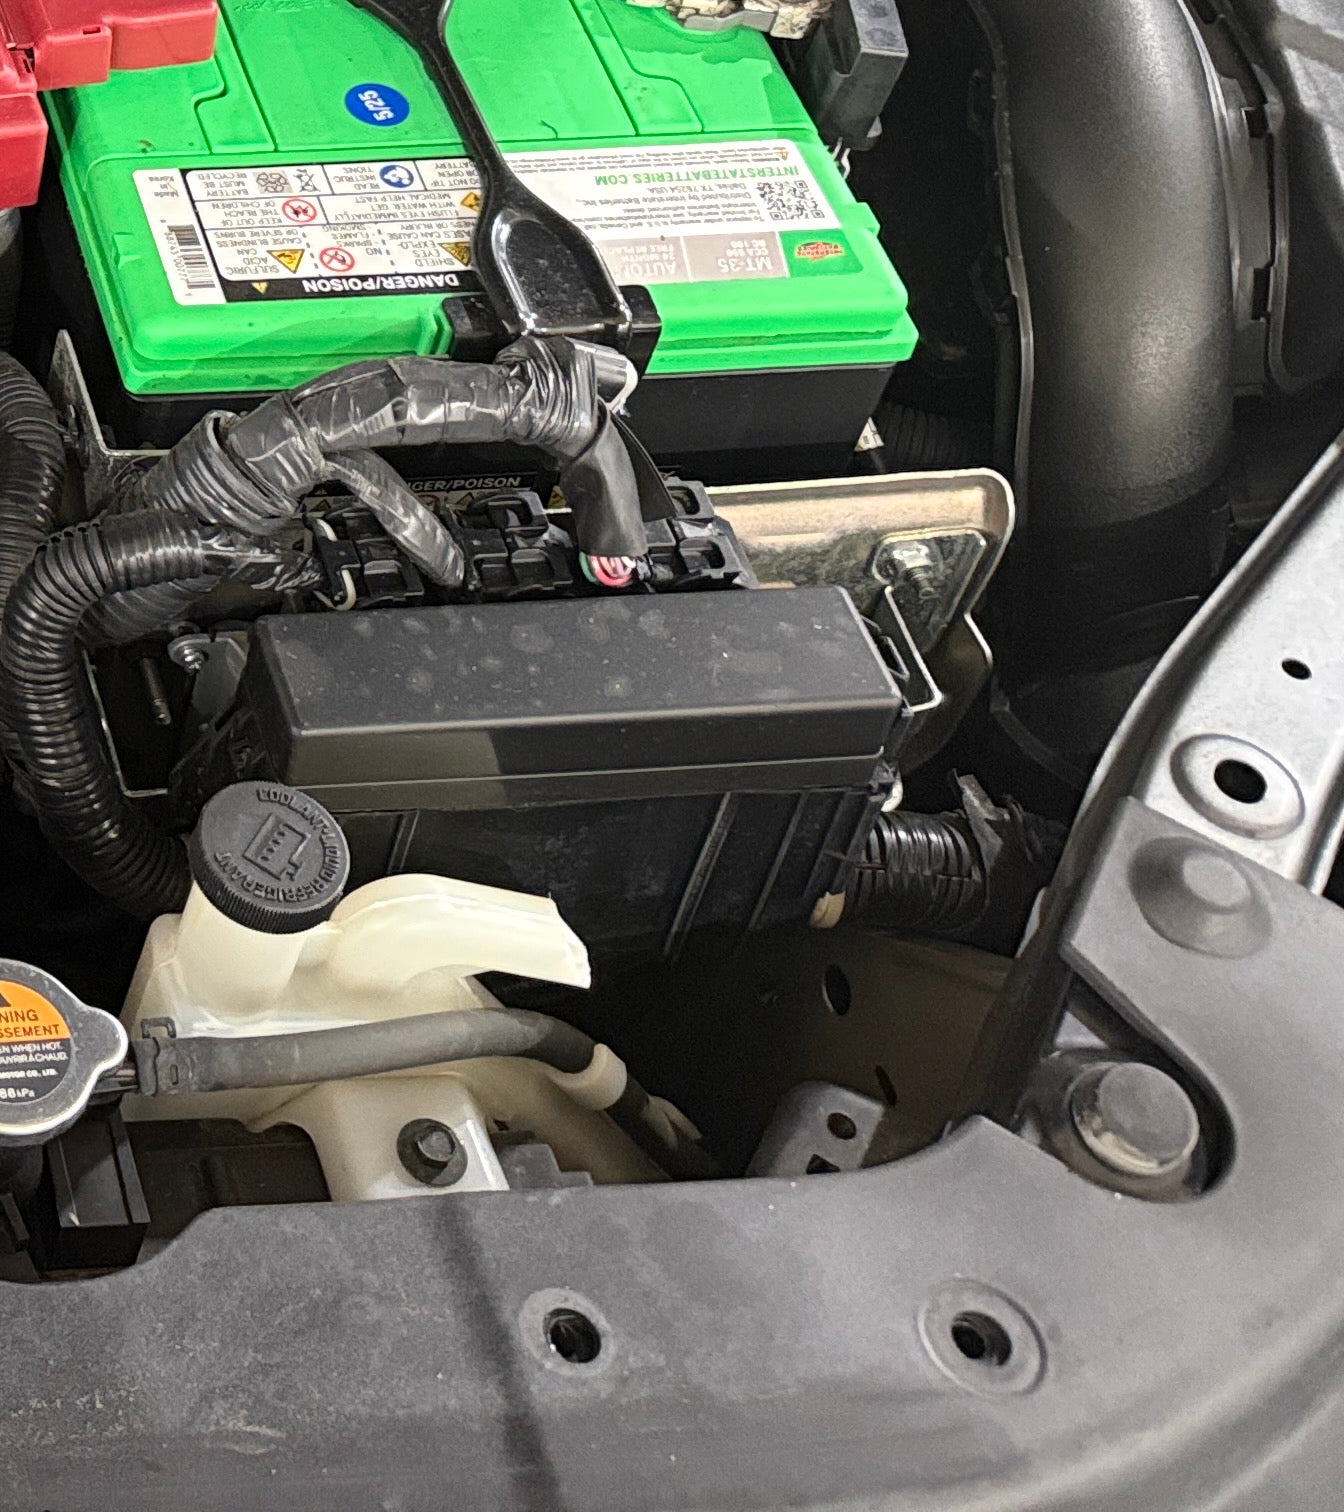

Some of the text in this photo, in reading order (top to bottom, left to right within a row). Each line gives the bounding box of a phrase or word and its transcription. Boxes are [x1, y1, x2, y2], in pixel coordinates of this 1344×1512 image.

[358, 90, 395, 121] 5/25
[342, 166, 373, 174] TIONS
[437, 170, 463, 178] OPEN
[594, 164, 800, 186] INTERSTATEBATTERIES.COM
[448, 178, 467, 186] NOT
[380, 194, 406, 202] HELP
[409, 193, 451, 201] MEDICAL
[212, 201, 260, 209] CHILDREN
[428, 209, 458, 218] FLUSH
[322, 224, 366, 232] SMOKING
[331, 232, 369, 240] FLAMES
[387, 232, 418, 240] CAUSE
[420, 231, 440, 239] CAN
[216, 237, 302, 247] CAUSE BLINDNESS
[365, 247, 382, 256] NO
[412, 249, 440, 257] EYES
[746, 248, 768, 256] CCA
[243, 257, 268, 265] ACID
[415, 258, 454, 267] SHIELD
[717, 256, 773, 272] MT-35
[225, 265, 279, 274] SULFURIC
[302, 273, 460, 293] DANGER/POISON
[406, 476, 522, 492] GER/POISON
[12, 1043, 41, 1054] WHEN
